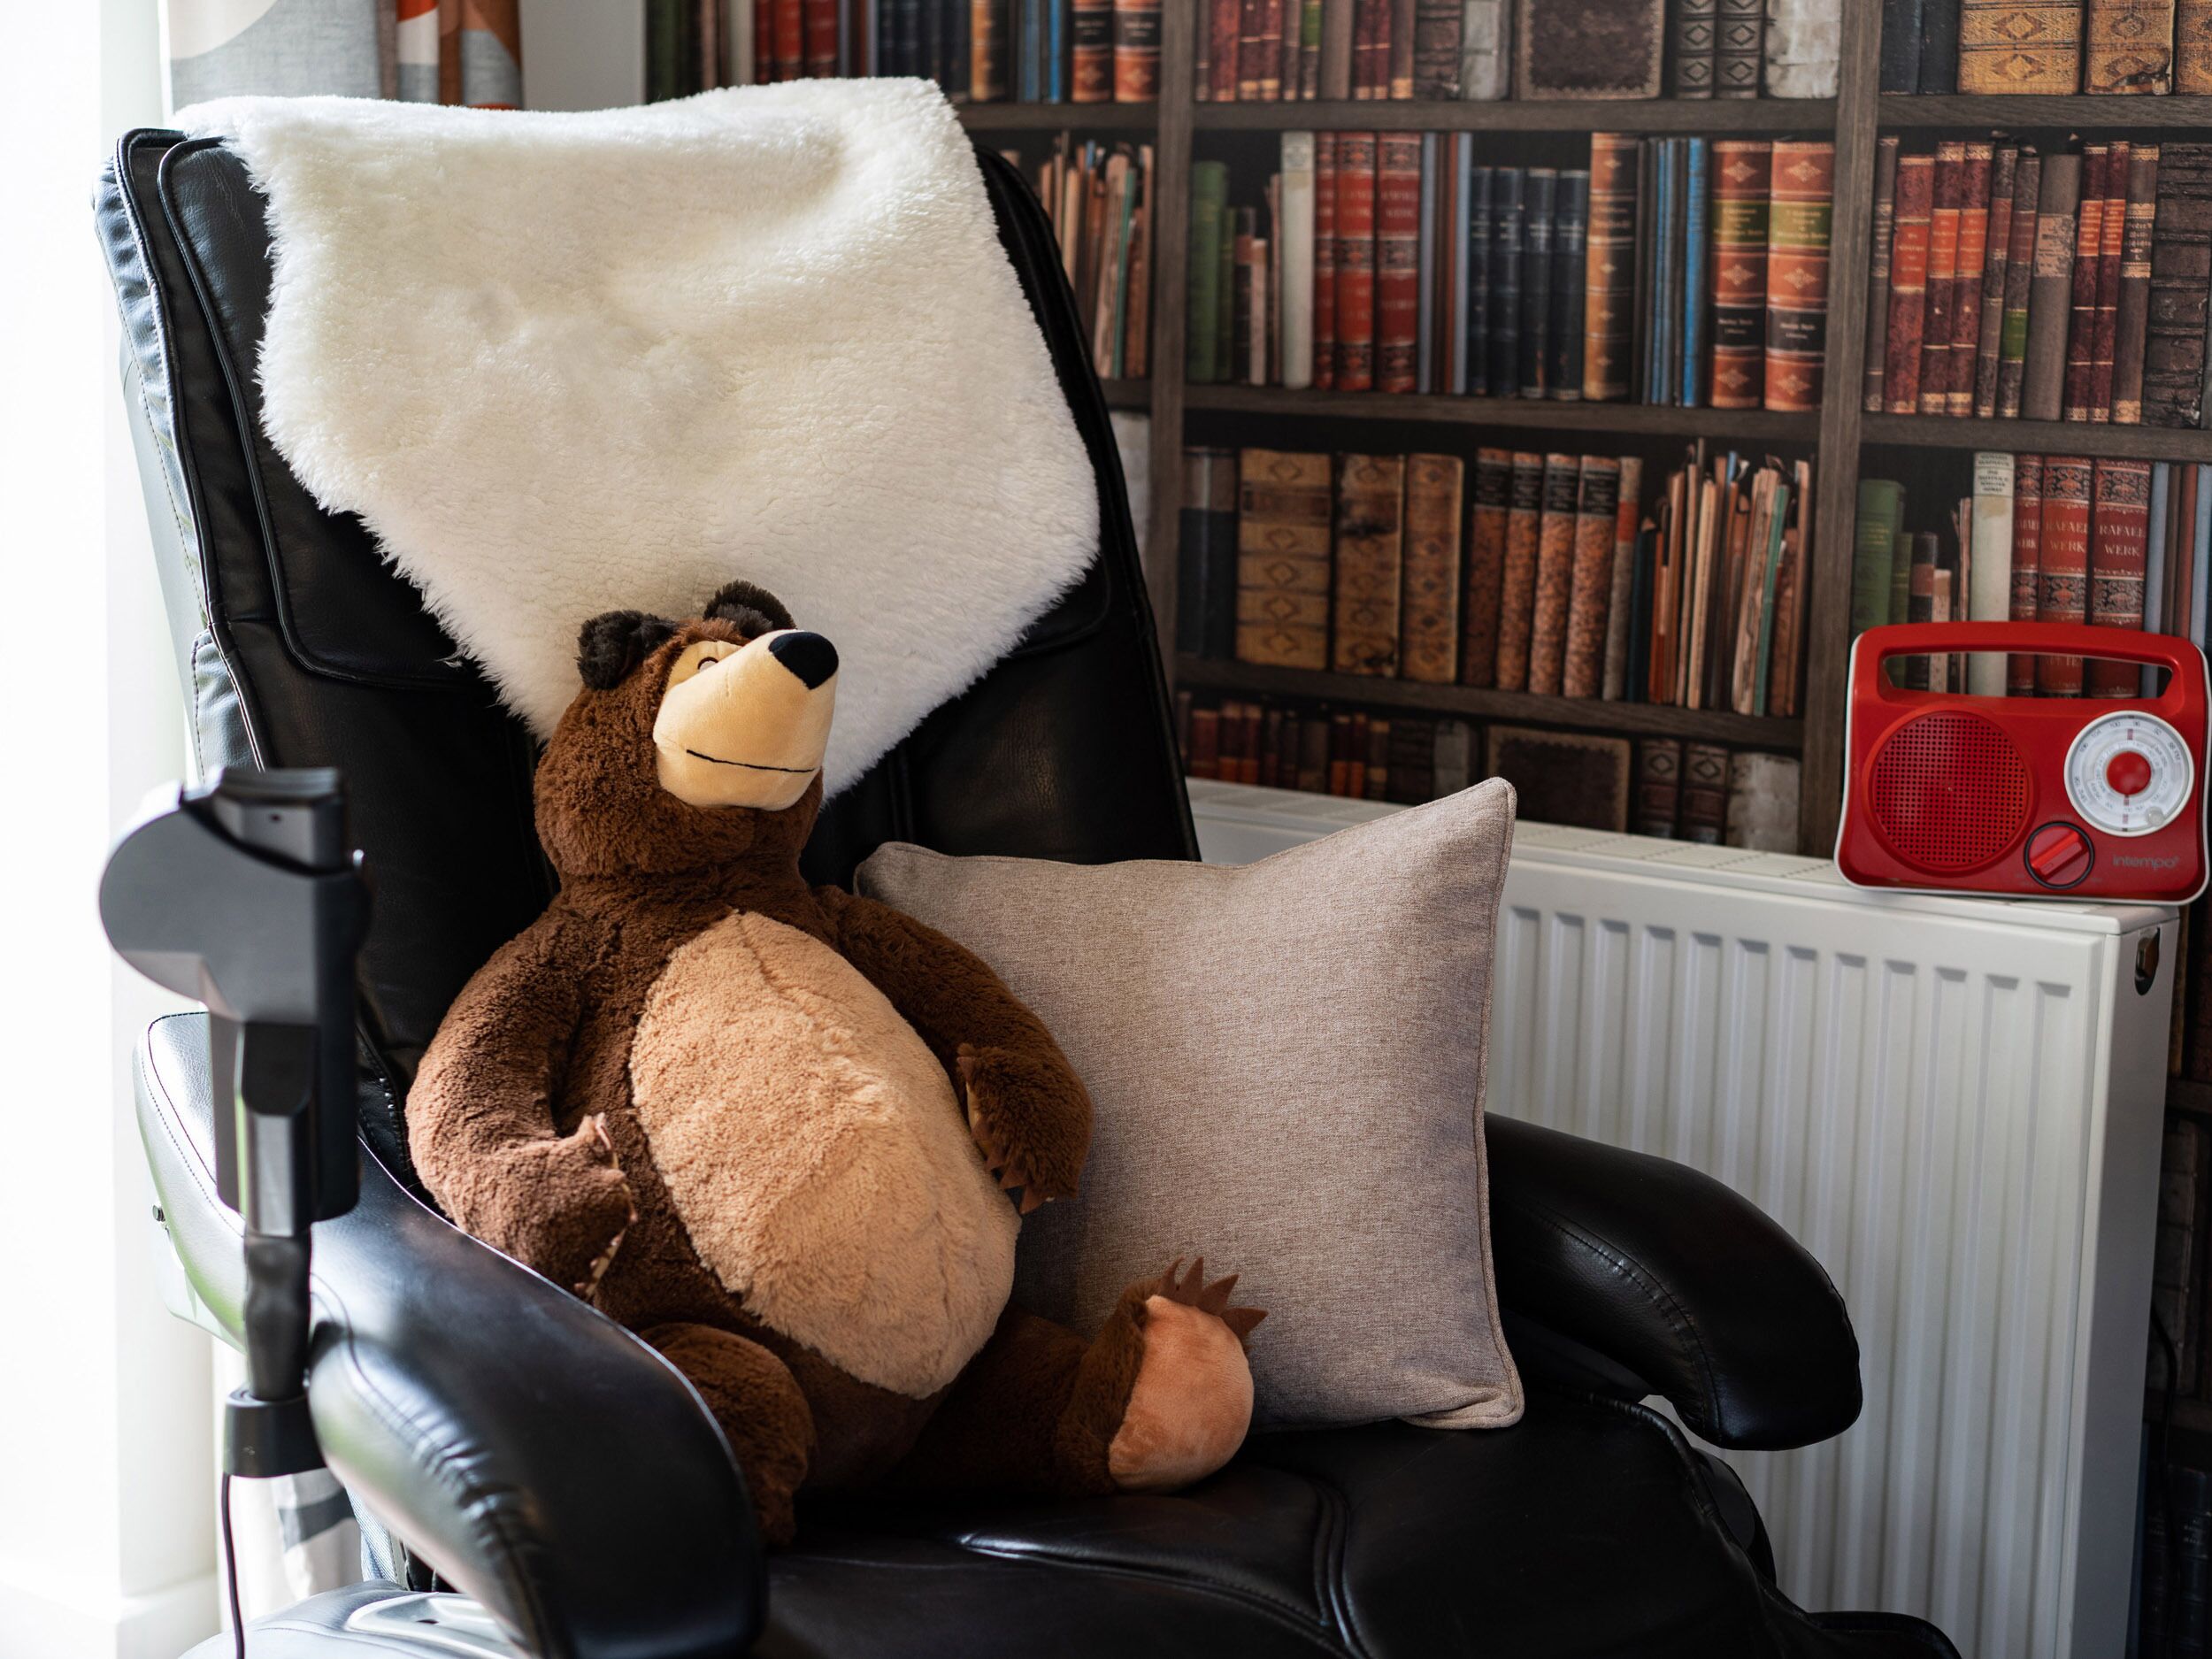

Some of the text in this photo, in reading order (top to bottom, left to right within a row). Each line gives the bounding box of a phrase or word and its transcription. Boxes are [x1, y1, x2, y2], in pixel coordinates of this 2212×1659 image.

[2099, 524, 2145, 538] RAFAEL
[2050, 540, 2085, 553] WERK
[2104, 543, 2141, 557] WERK
[2112, 854, 2177, 870] intempo
